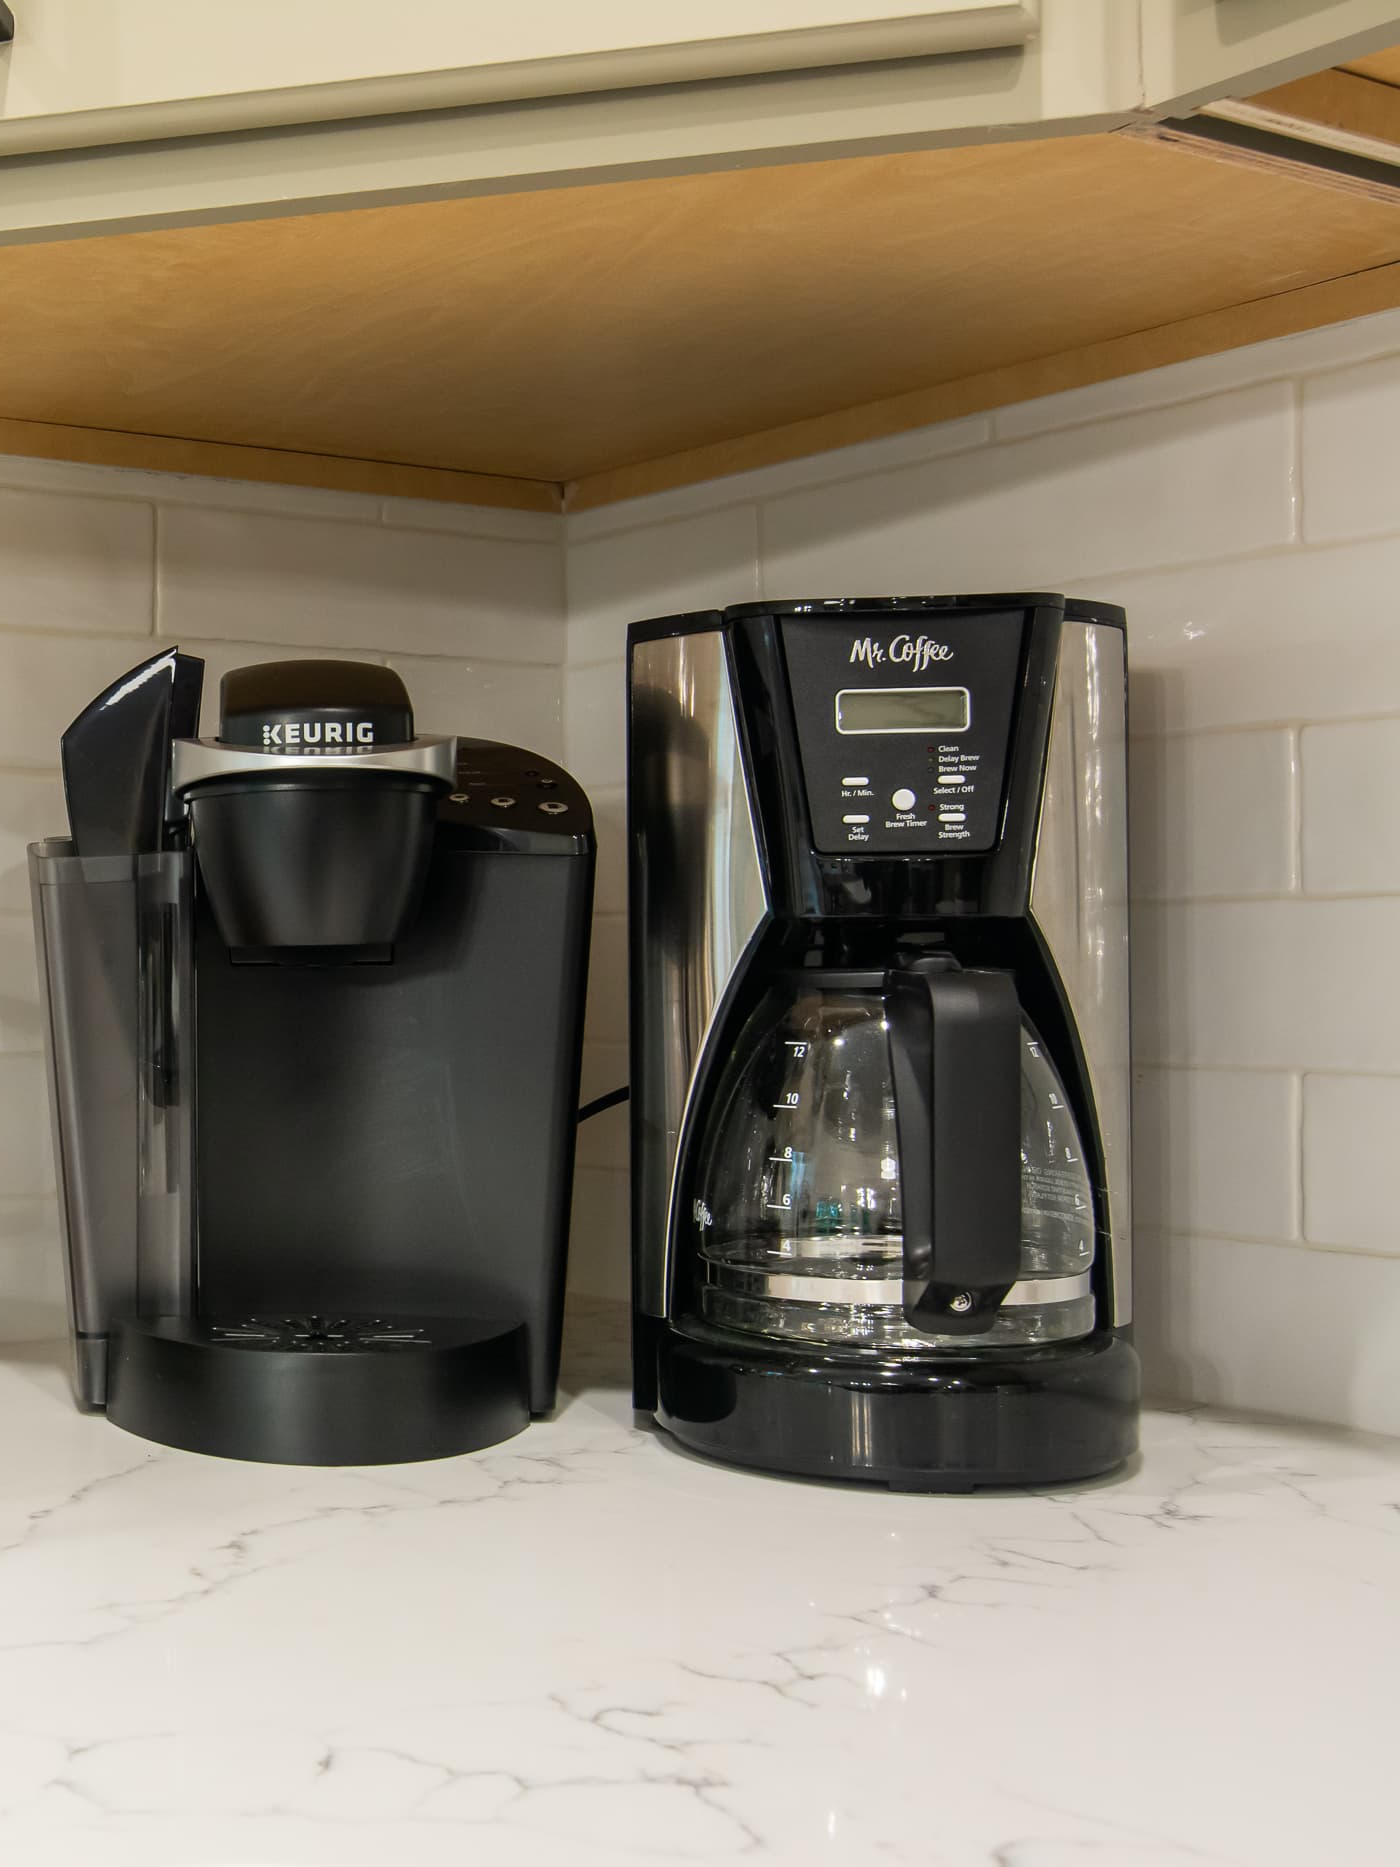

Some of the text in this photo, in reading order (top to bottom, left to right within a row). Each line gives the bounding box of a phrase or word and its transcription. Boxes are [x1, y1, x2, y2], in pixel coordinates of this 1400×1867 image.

[849, 634, 954, 672] Mr. Coffee
[263, 722, 374, 745] KEURIG
[938, 754, 980, 764] Delay Brew
[938, 764, 977, 773] Brew Now
[857, 789, 875, 797] Min.
[933, 786, 956, 795] Select
[961, 785, 975, 794] Off
[939, 803, 965, 812] Strong
[895, 812, 916, 821] Fresh
[885, 819, 928, 828] Brew Timer
[944, 824, 964, 832] Brew
[851, 826, 865, 834] Set
[938, 830, 971, 840] Strength
[848, 833, 870, 842] Delay
[793, 1046, 806, 1058] 12
[786, 1092, 800, 1105] 10
[783, 1146, 793, 1159] 8
[782, 1193, 791, 1206] 6
[782, 1239, 792, 1252] 4
